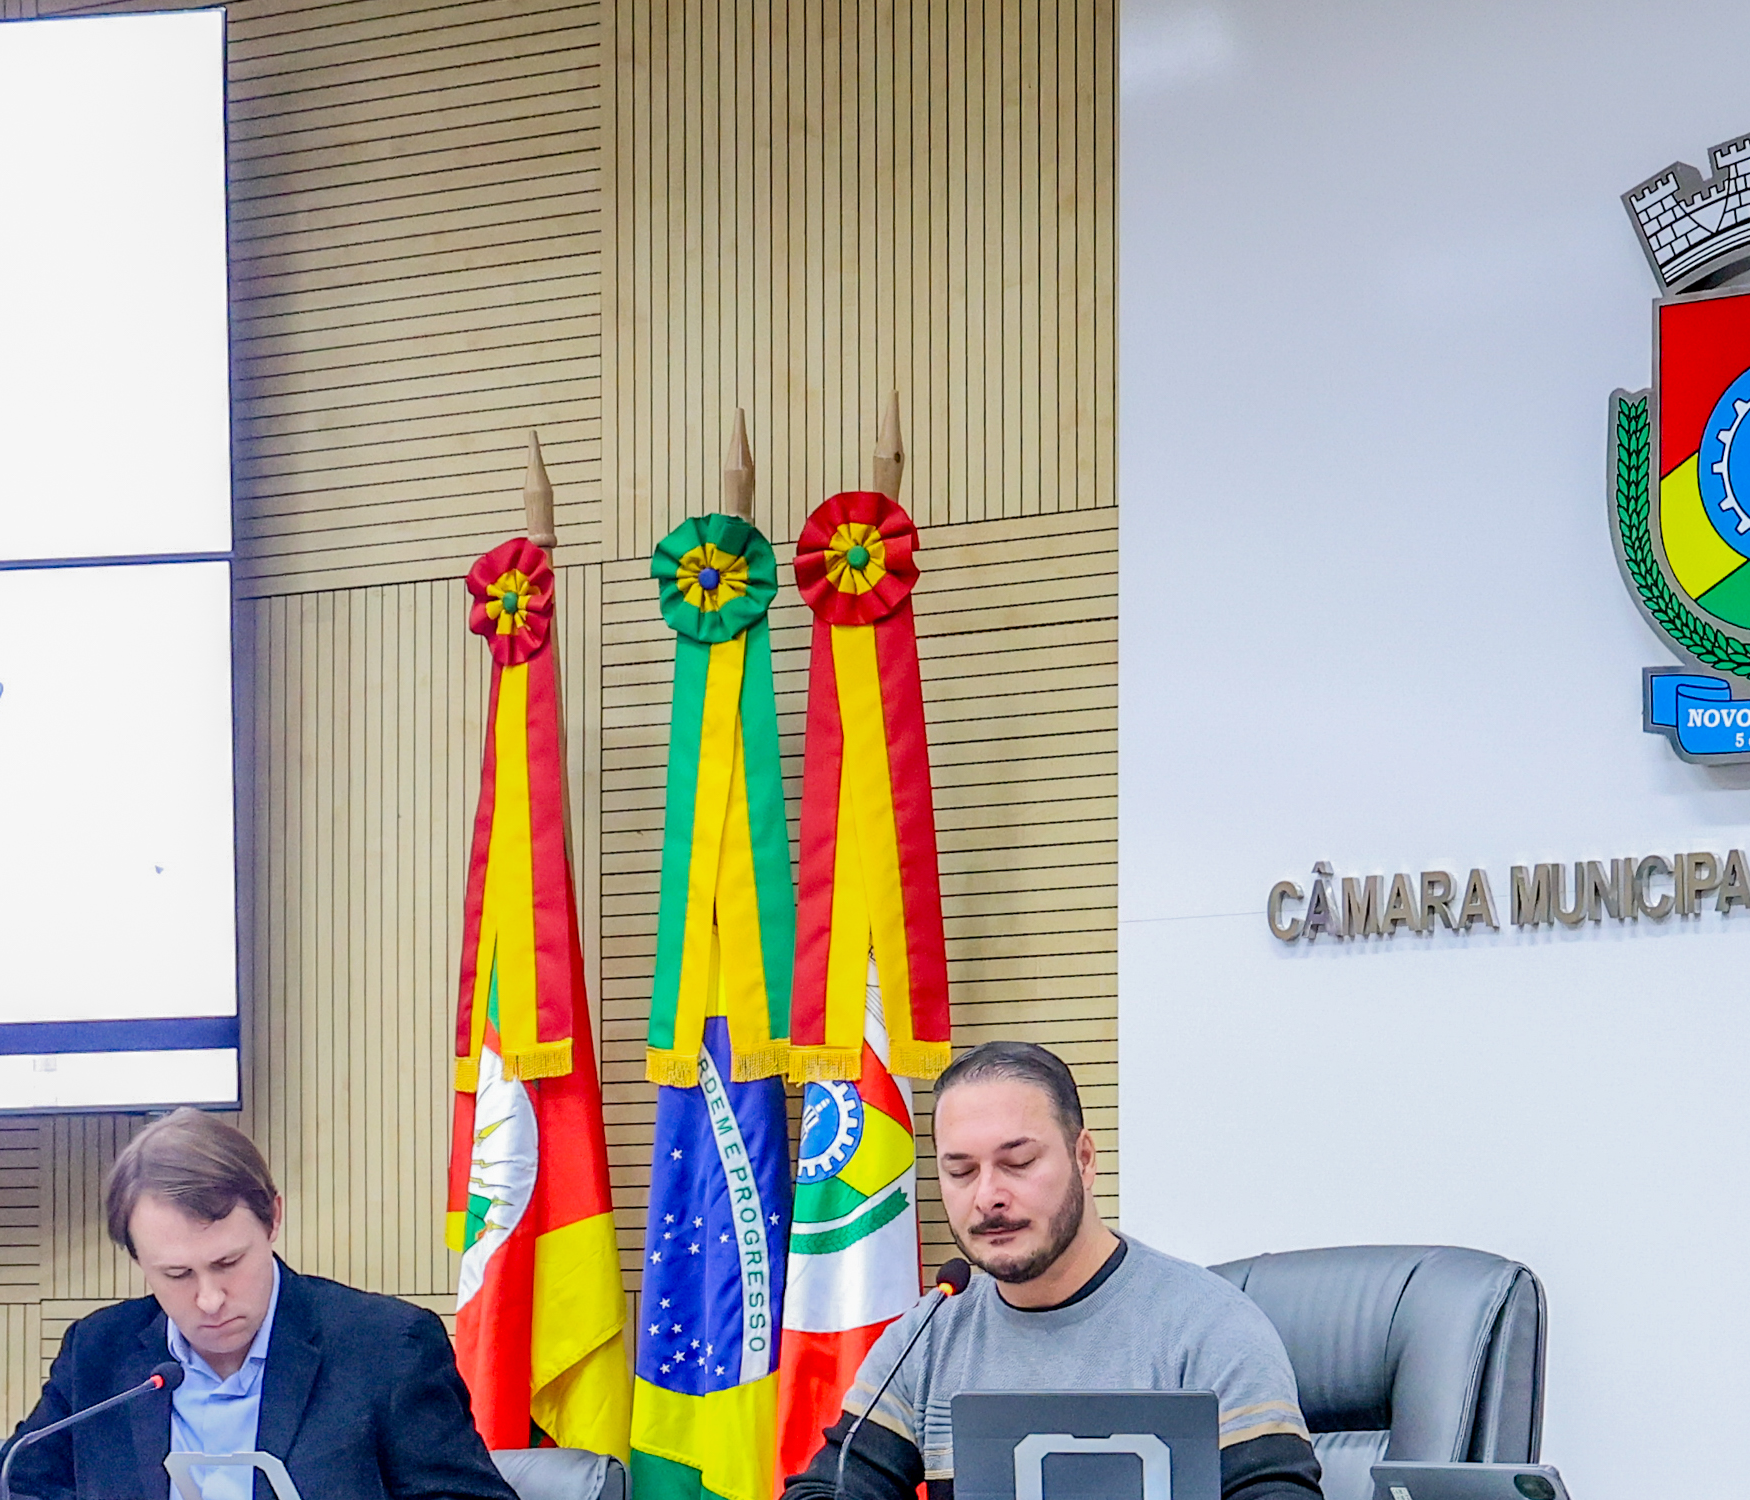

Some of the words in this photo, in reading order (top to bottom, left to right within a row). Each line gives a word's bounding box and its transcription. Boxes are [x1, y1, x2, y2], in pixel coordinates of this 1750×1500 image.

[1735, 732, 1745, 748] 5
[1267, 861, 1500, 942] CÂMARA
[698, 1057, 734, 1137] RDEM
[724, 1142, 741, 1160] E
[729, 1166, 766, 1353] PROGRESSO
